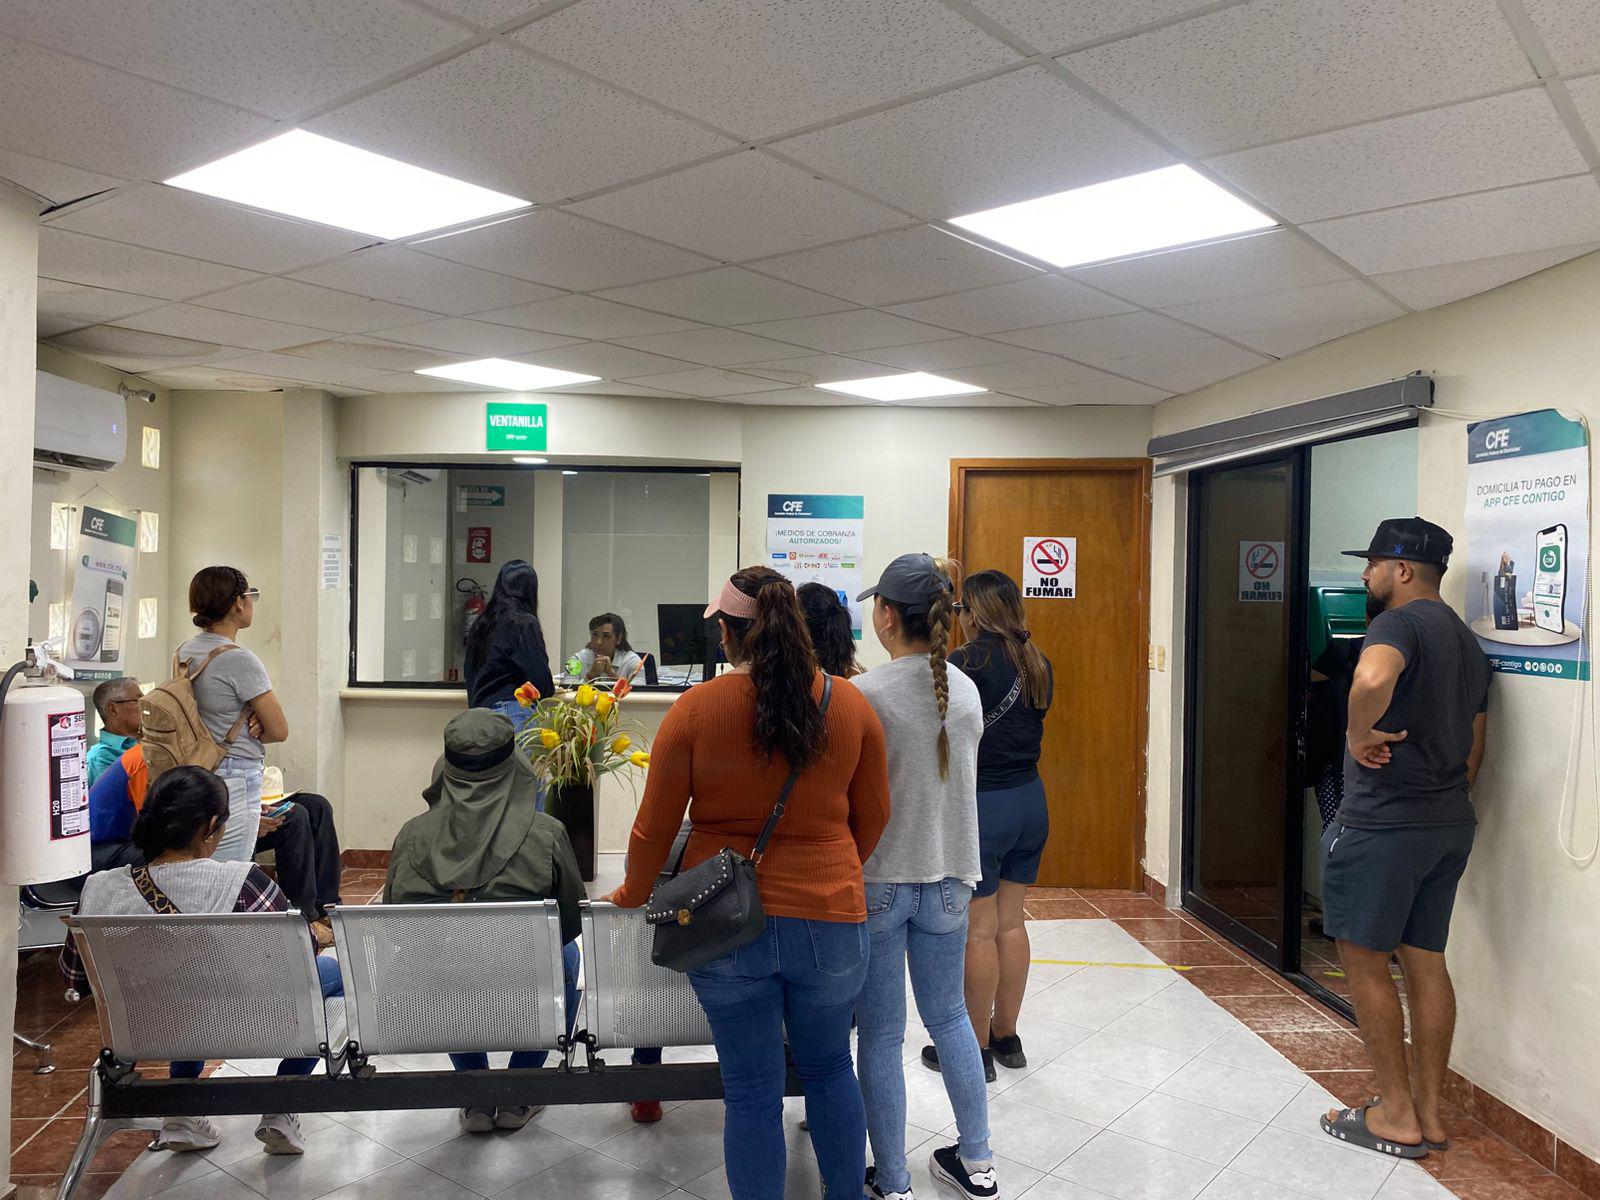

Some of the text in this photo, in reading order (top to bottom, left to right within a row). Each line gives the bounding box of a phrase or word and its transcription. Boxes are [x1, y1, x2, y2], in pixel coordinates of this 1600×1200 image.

[490, 414, 543, 428] VENTANILLA
[1485, 428, 1510, 449] CFE
[1477, 474, 1577, 495] DOMICILIA TU PAGO EN
[1484, 490, 1565, 508] APP CFE CONTIGO
[783, 501, 803, 512] CFE
[91, 517, 104, 531] CFE
[1040, 577, 1059, 587] NO
[1026, 587, 1073, 597] FUMAR
